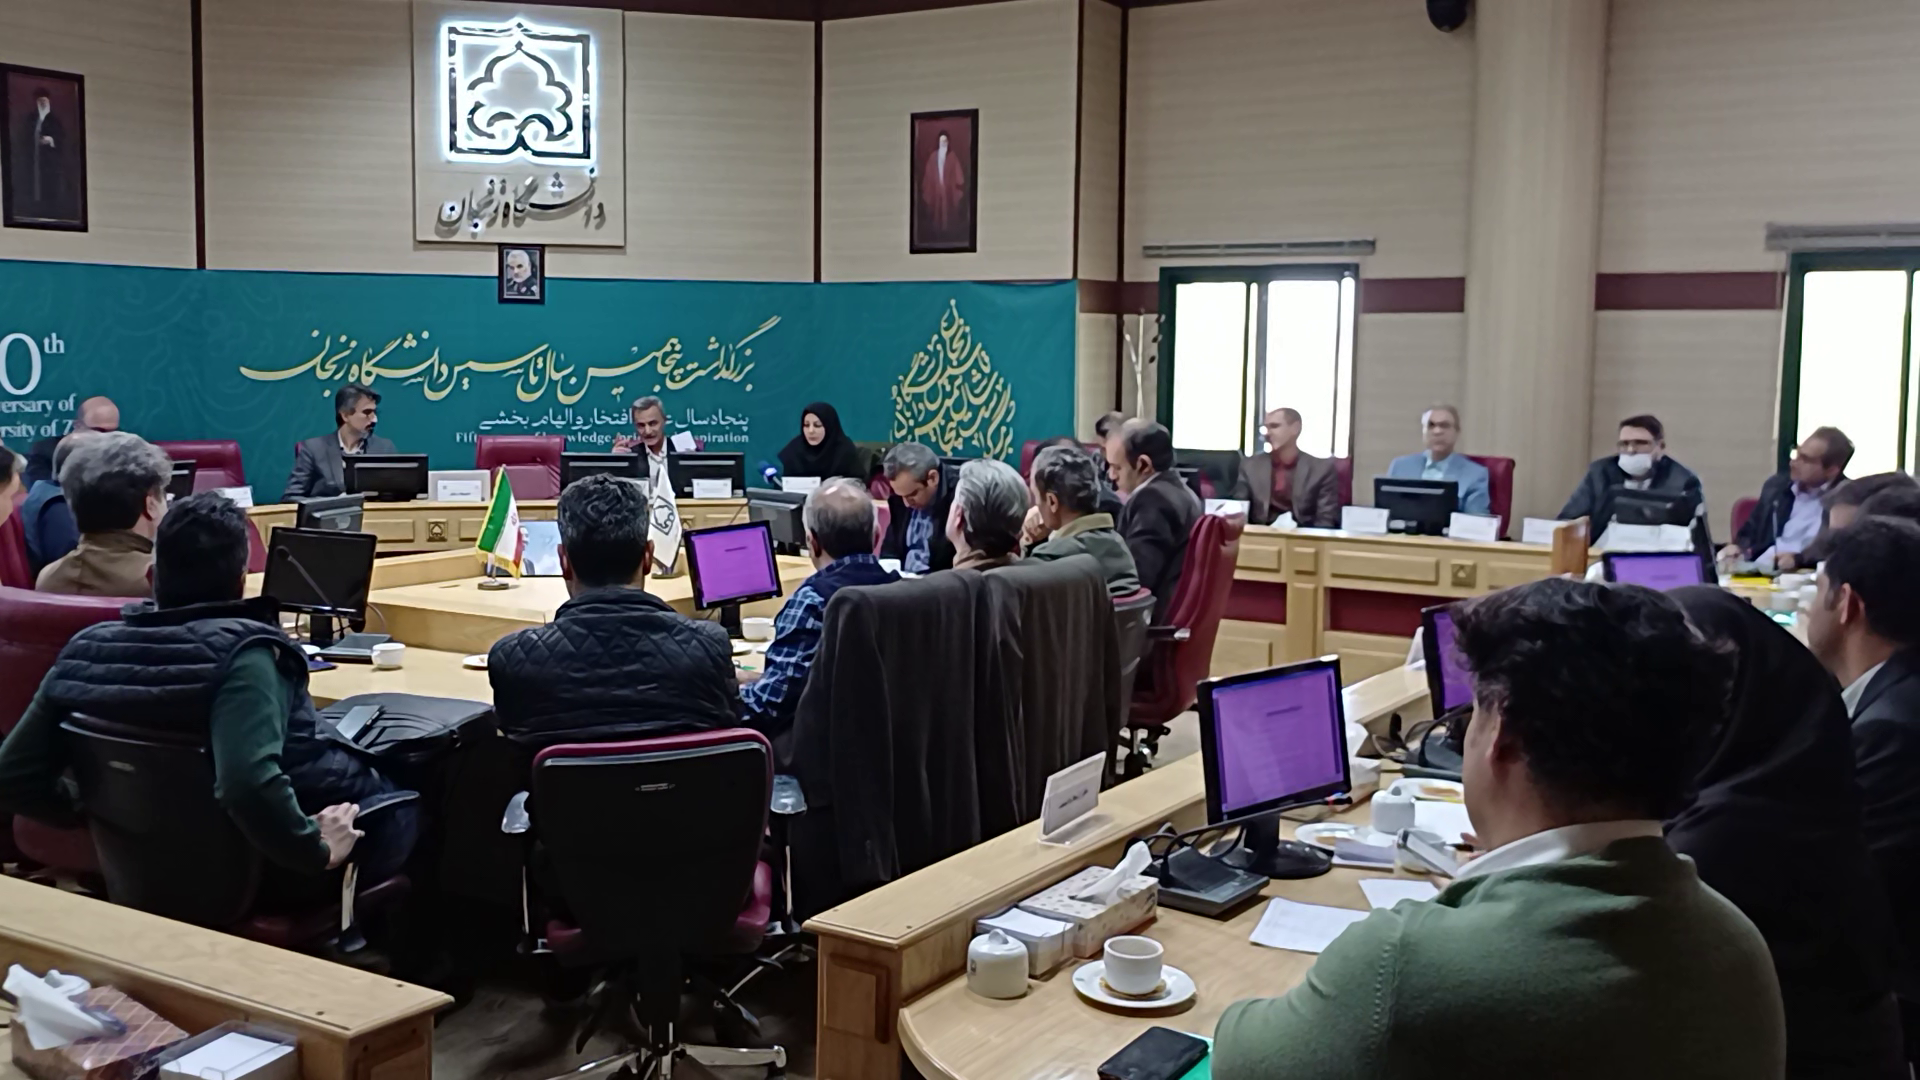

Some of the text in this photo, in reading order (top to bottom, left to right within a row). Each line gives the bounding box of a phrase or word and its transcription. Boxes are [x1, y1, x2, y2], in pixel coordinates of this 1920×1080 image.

[0, 332, 65, 396] 0th
[238, 328, 358, 398] زنجان
[347, 329, 450, 387] دانشگاه
[0, 392, 77, 418] ersary of
[0, 421, 37, 443] rsity
[40, 418, 60, 438] of
